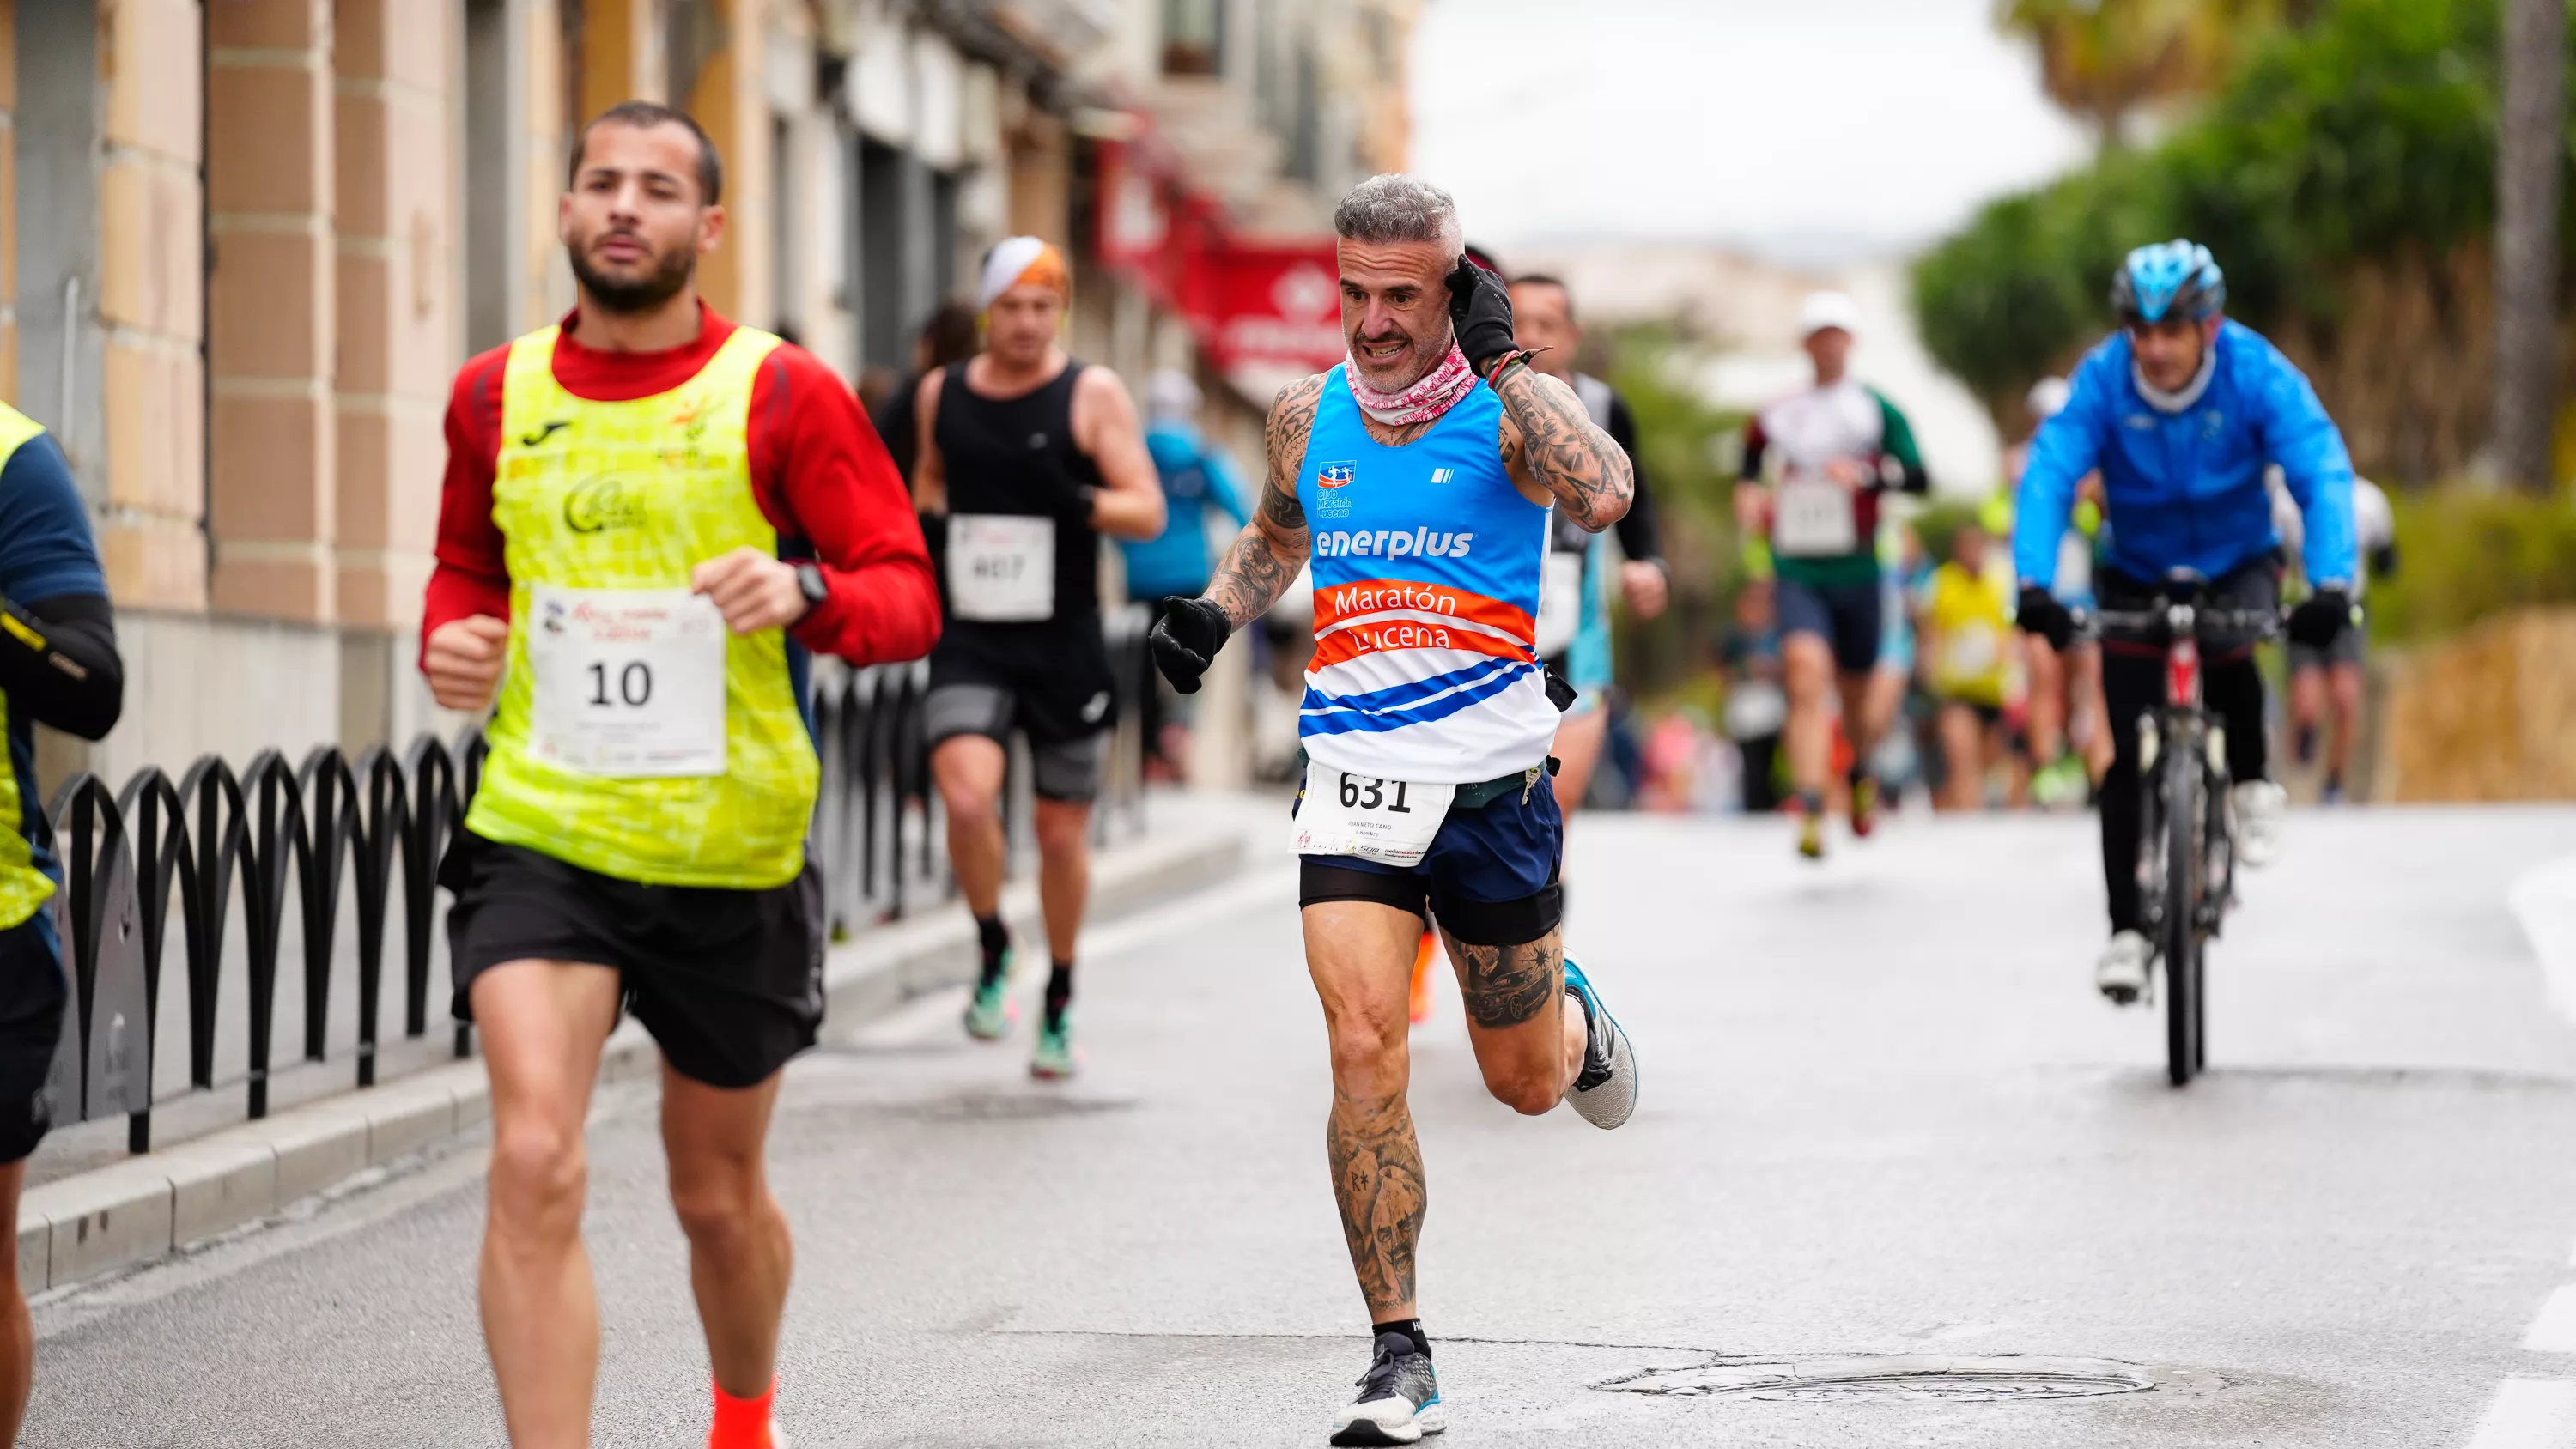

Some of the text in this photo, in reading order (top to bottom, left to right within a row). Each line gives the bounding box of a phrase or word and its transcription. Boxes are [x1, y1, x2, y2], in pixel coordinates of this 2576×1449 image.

[1317, 488, 1338, 500] Club
[1317, 497, 1353, 509] Maratón
[1317, 509, 1350, 518] Lucena
[1316, 526, 1474, 561] enerplus
[1334, 585, 1457, 616] Maratón
[1347, 626, 1451, 652] Lucena
[586, 658, 653, 707] 10
[1340, 771, 1411, 813] 631
